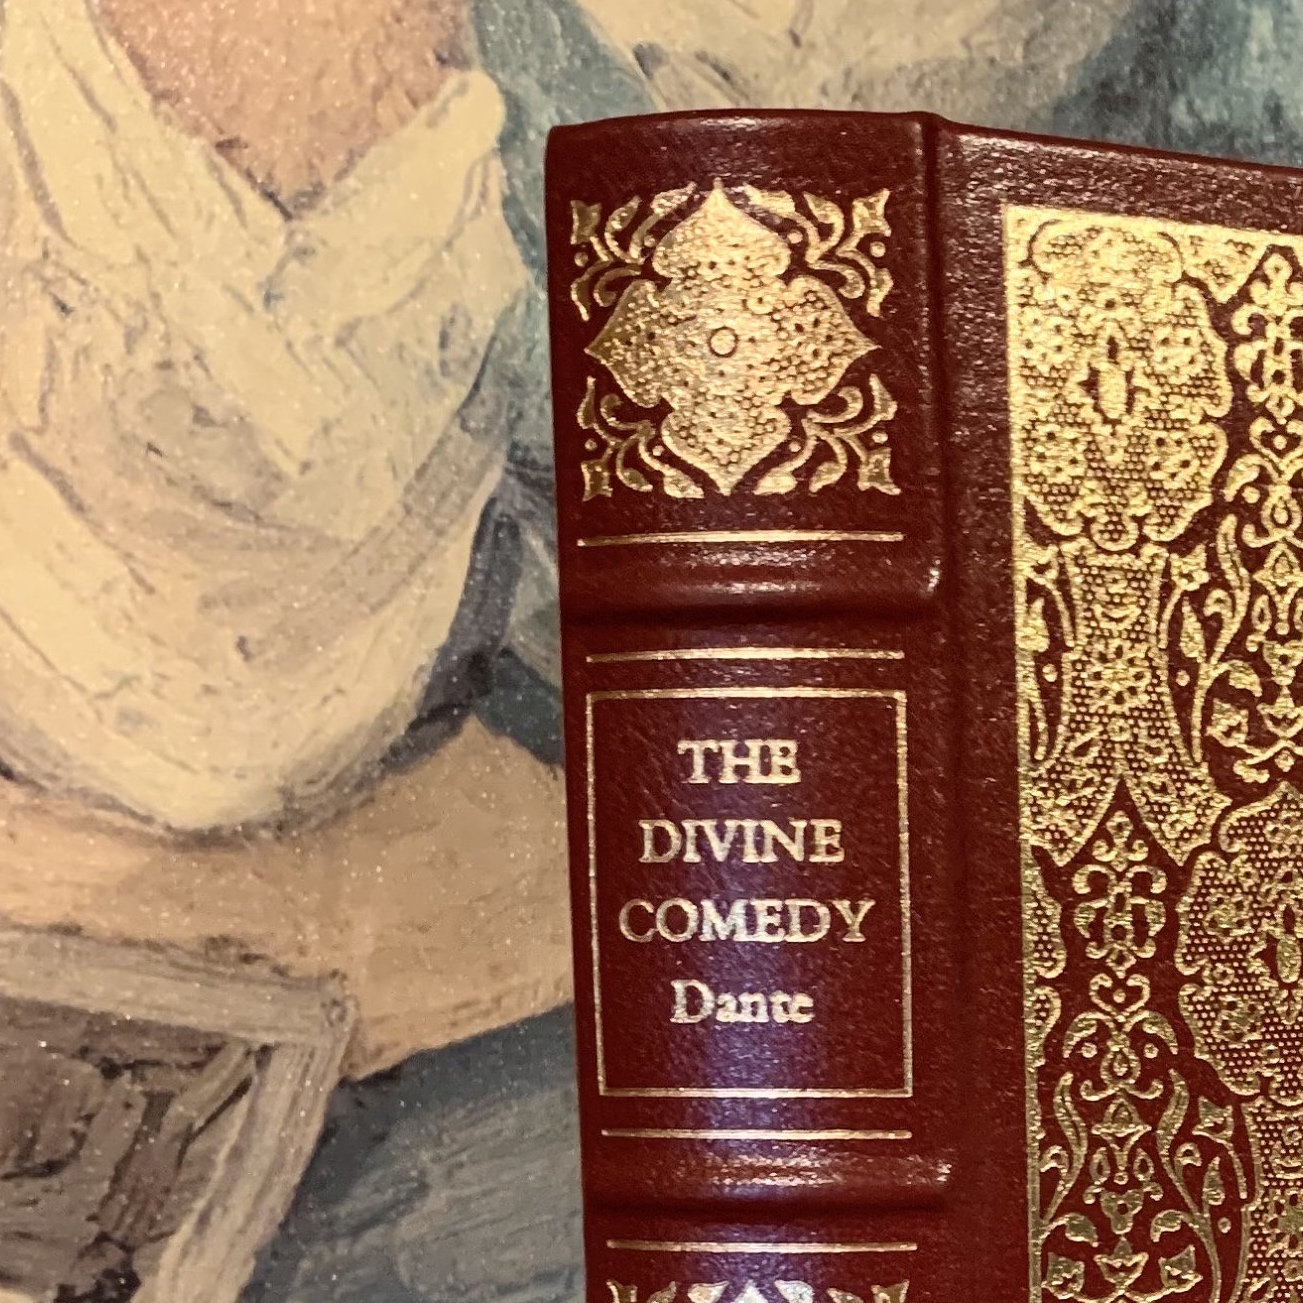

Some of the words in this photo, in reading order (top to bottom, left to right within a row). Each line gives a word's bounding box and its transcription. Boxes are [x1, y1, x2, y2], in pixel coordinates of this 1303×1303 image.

[677, 739, 802, 784] THE
[638, 818, 845, 863] DIVINE
[618, 897, 877, 943] COMEDY
[669, 979, 815, 1024] Dante
